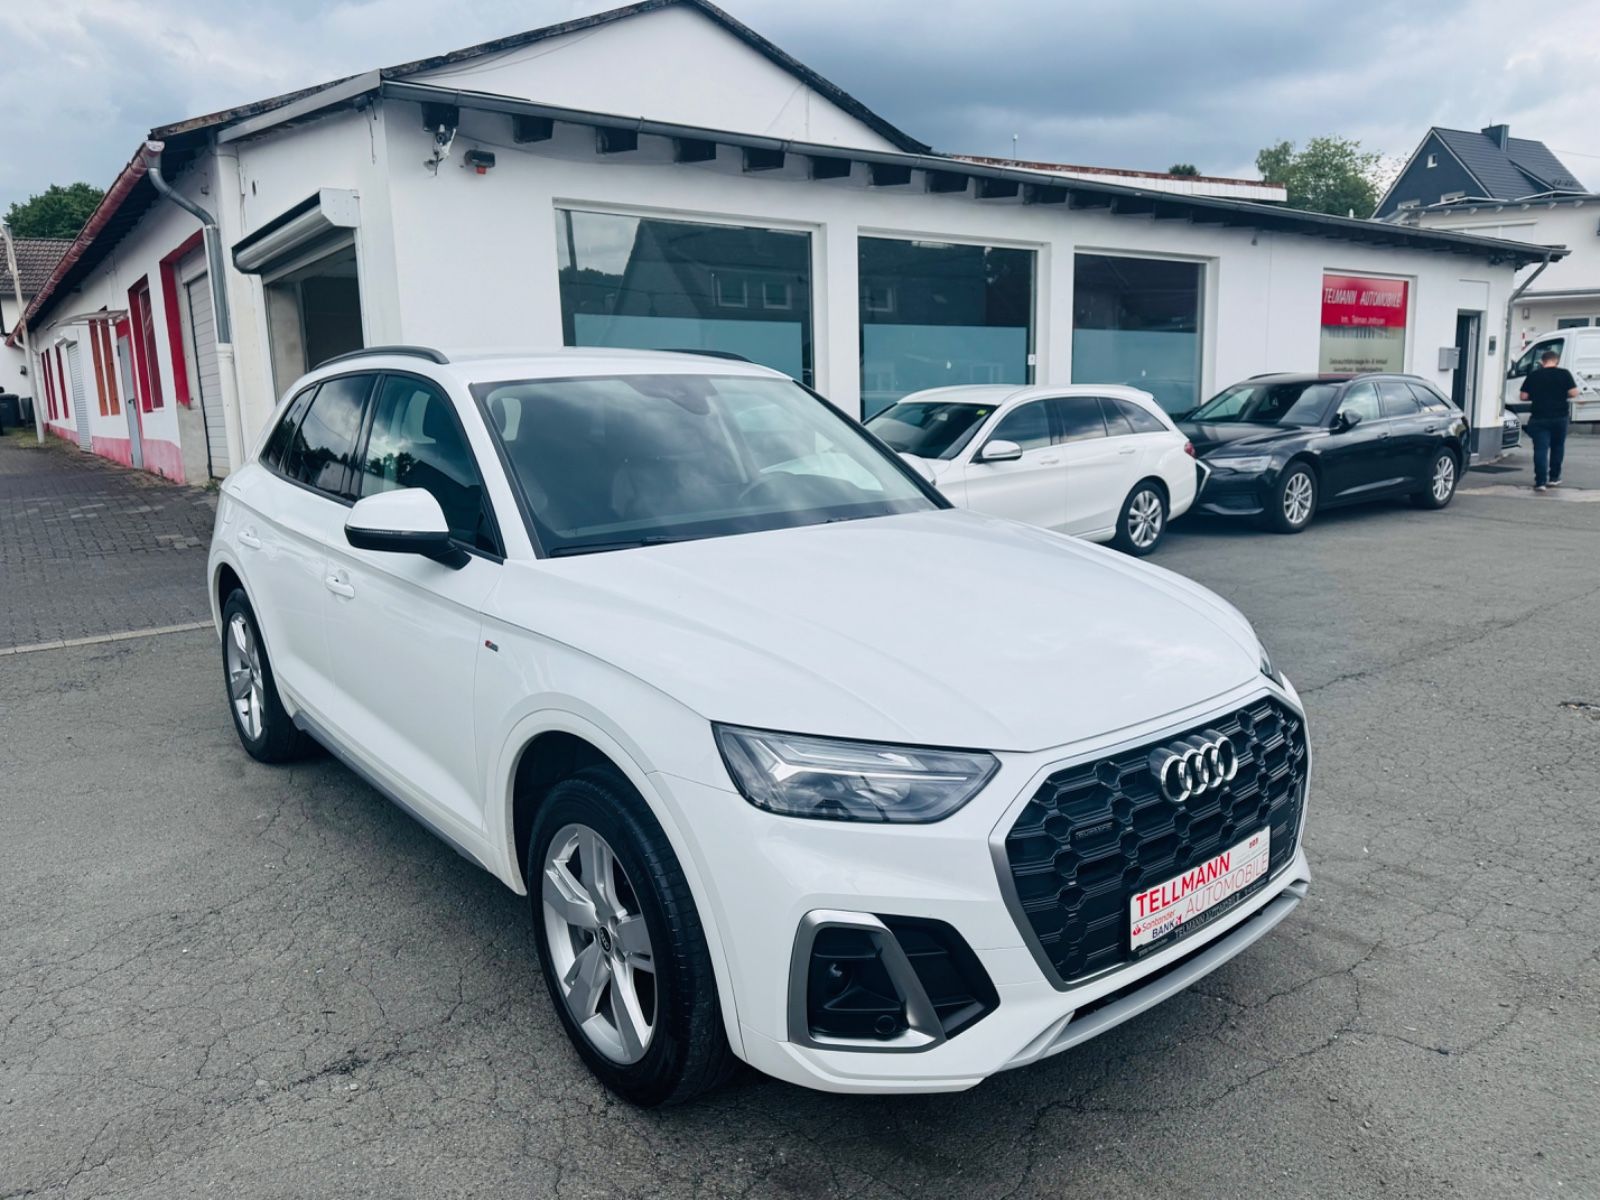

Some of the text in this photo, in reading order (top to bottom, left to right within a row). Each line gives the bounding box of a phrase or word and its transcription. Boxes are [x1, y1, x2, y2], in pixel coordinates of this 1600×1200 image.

[1360, 291, 1401, 308] AUTOMOBILE
[1136, 851, 1231, 917] TELLMANN
[1186, 852, 1268, 915] AUTOMOBILE
[1142, 909, 1176, 932] Santander
